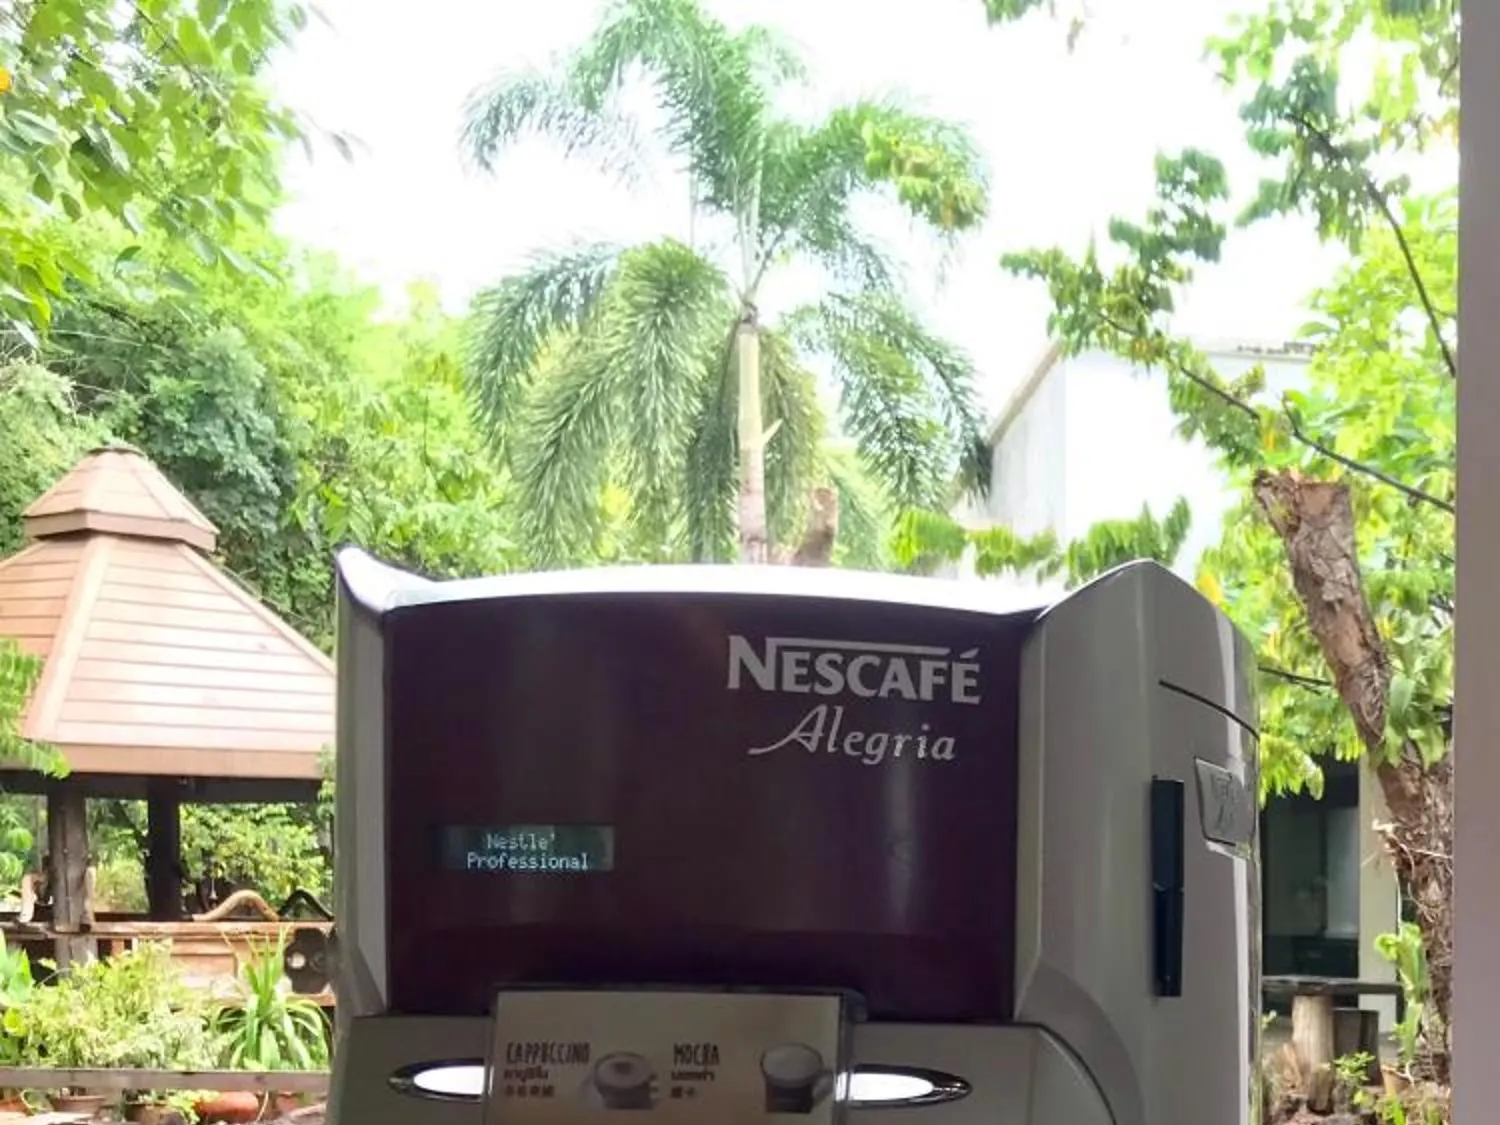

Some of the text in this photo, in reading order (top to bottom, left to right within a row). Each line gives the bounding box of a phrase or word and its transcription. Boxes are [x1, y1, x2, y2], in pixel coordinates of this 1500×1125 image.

[727, 635, 980, 704] NESCAFÉ
[748, 704, 955, 765] Alegria
[467, 852, 589, 870] Professional
